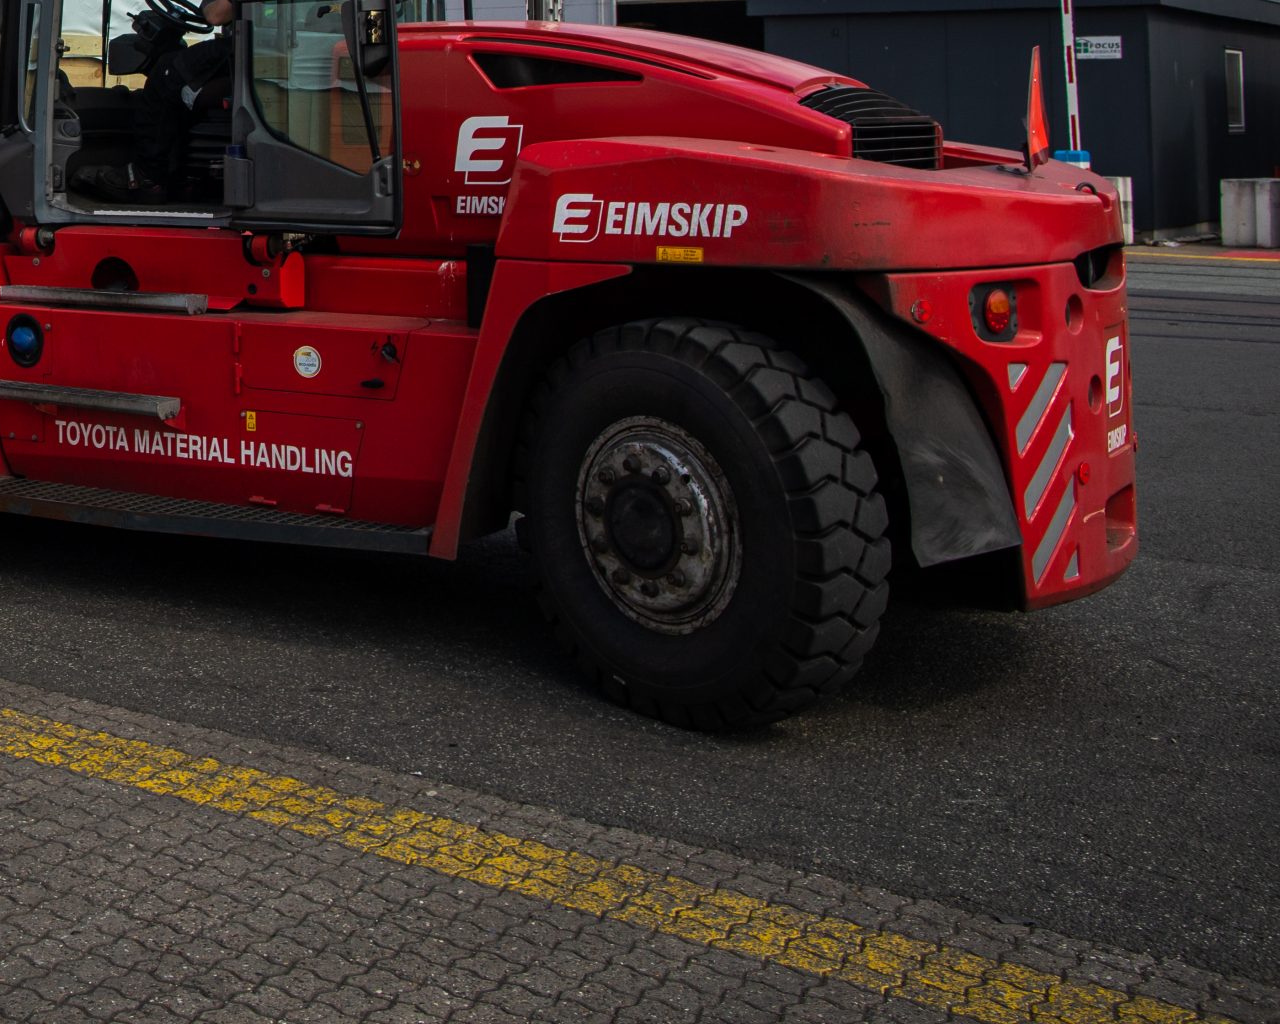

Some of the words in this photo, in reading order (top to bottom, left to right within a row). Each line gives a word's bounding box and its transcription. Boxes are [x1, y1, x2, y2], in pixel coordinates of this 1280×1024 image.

[605, 201, 748, 238] EIMSKIP
[55, 420, 129, 451] TOYOTA
[134, 429, 235, 464] MATERIAL
[241, 441, 353, 477] HANDLING
